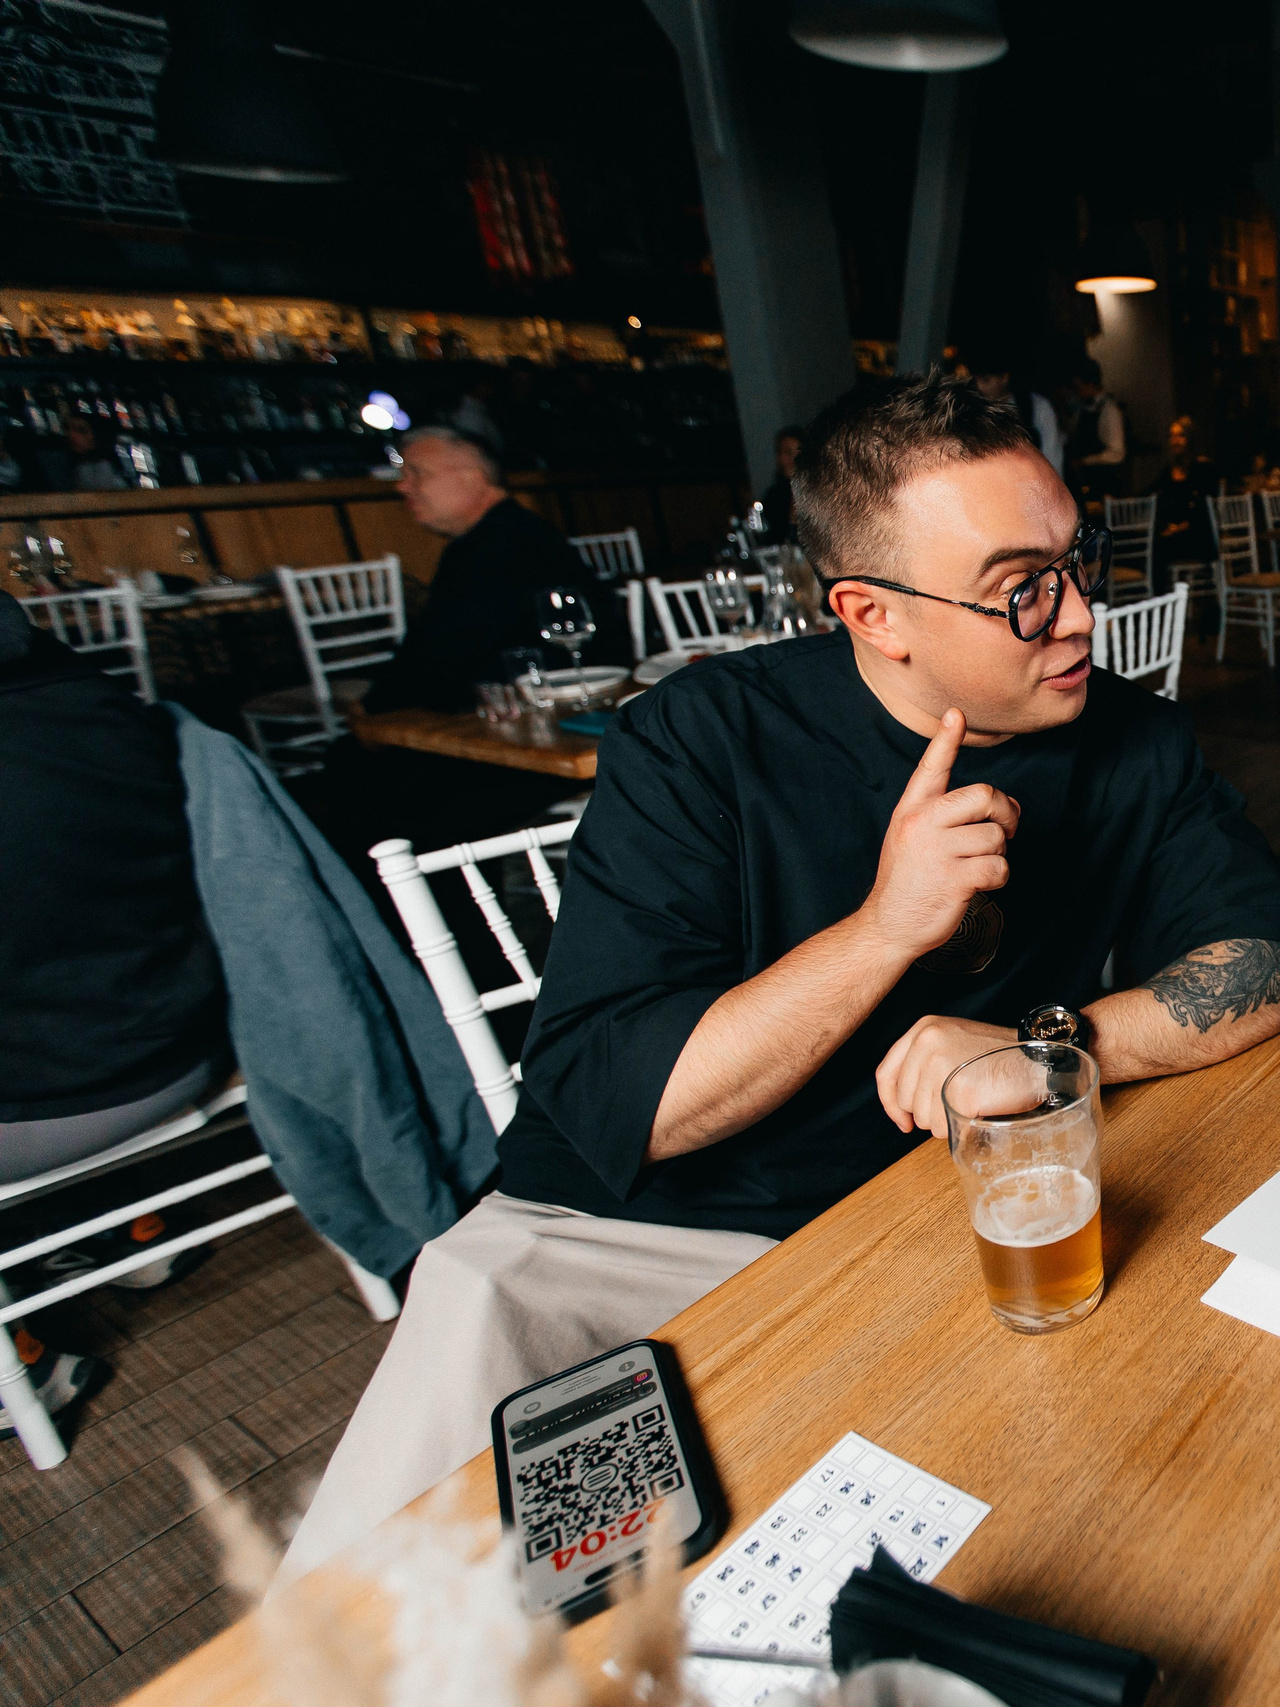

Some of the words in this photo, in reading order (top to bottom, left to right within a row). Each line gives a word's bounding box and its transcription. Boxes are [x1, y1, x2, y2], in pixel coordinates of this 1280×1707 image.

[820, 1469, 835, 1483] 17
[815, 1502, 833, 1518] 23
[770, 1514, 787, 1531] 39
[551, 1498, 666, 1572] 22:04
[790, 1526, 808, 1543] 32
[866, 1529, 882, 1547] 21
[908, 1554, 928, 1576] 22
[738, 1578, 755, 1595] 59
[689, 1591, 707, 1611] 67
[762, 1592, 777, 1610] 57
